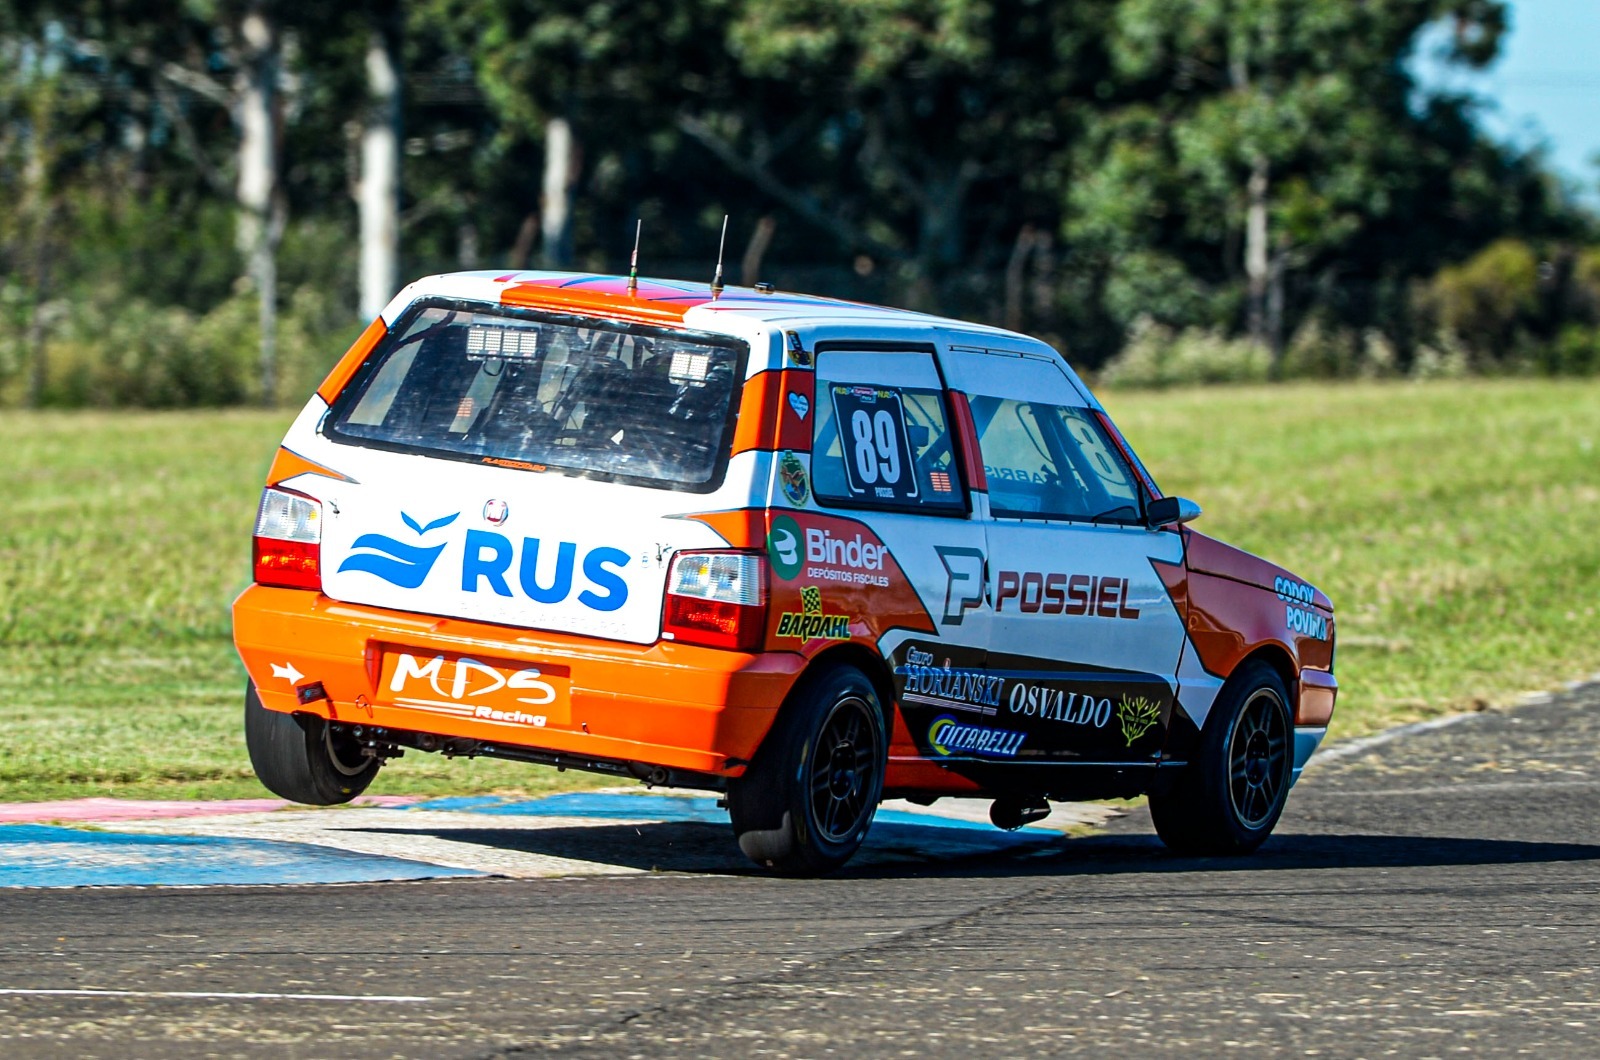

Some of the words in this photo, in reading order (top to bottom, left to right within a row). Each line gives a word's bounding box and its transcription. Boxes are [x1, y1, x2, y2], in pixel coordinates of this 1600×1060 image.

[851, 409, 901, 484] 89
[461, 528, 632, 612] RUS
[806, 528, 888, 570] Binder
[807, 567, 853, 583] DEPÓSITOS
[853, 573, 889, 588] FISCALES
[995, 570, 1140, 619] POSSIEL
[776, 611, 852, 645] BARDAHL
[390, 653, 556, 705] MDS
[903, 662, 1006, 707] HORIANSKI
[475, 705, 547, 727] Racing
[1009, 682, 1112, 729] OSVALDO
[934, 722, 1026, 756] CICCARELLI
